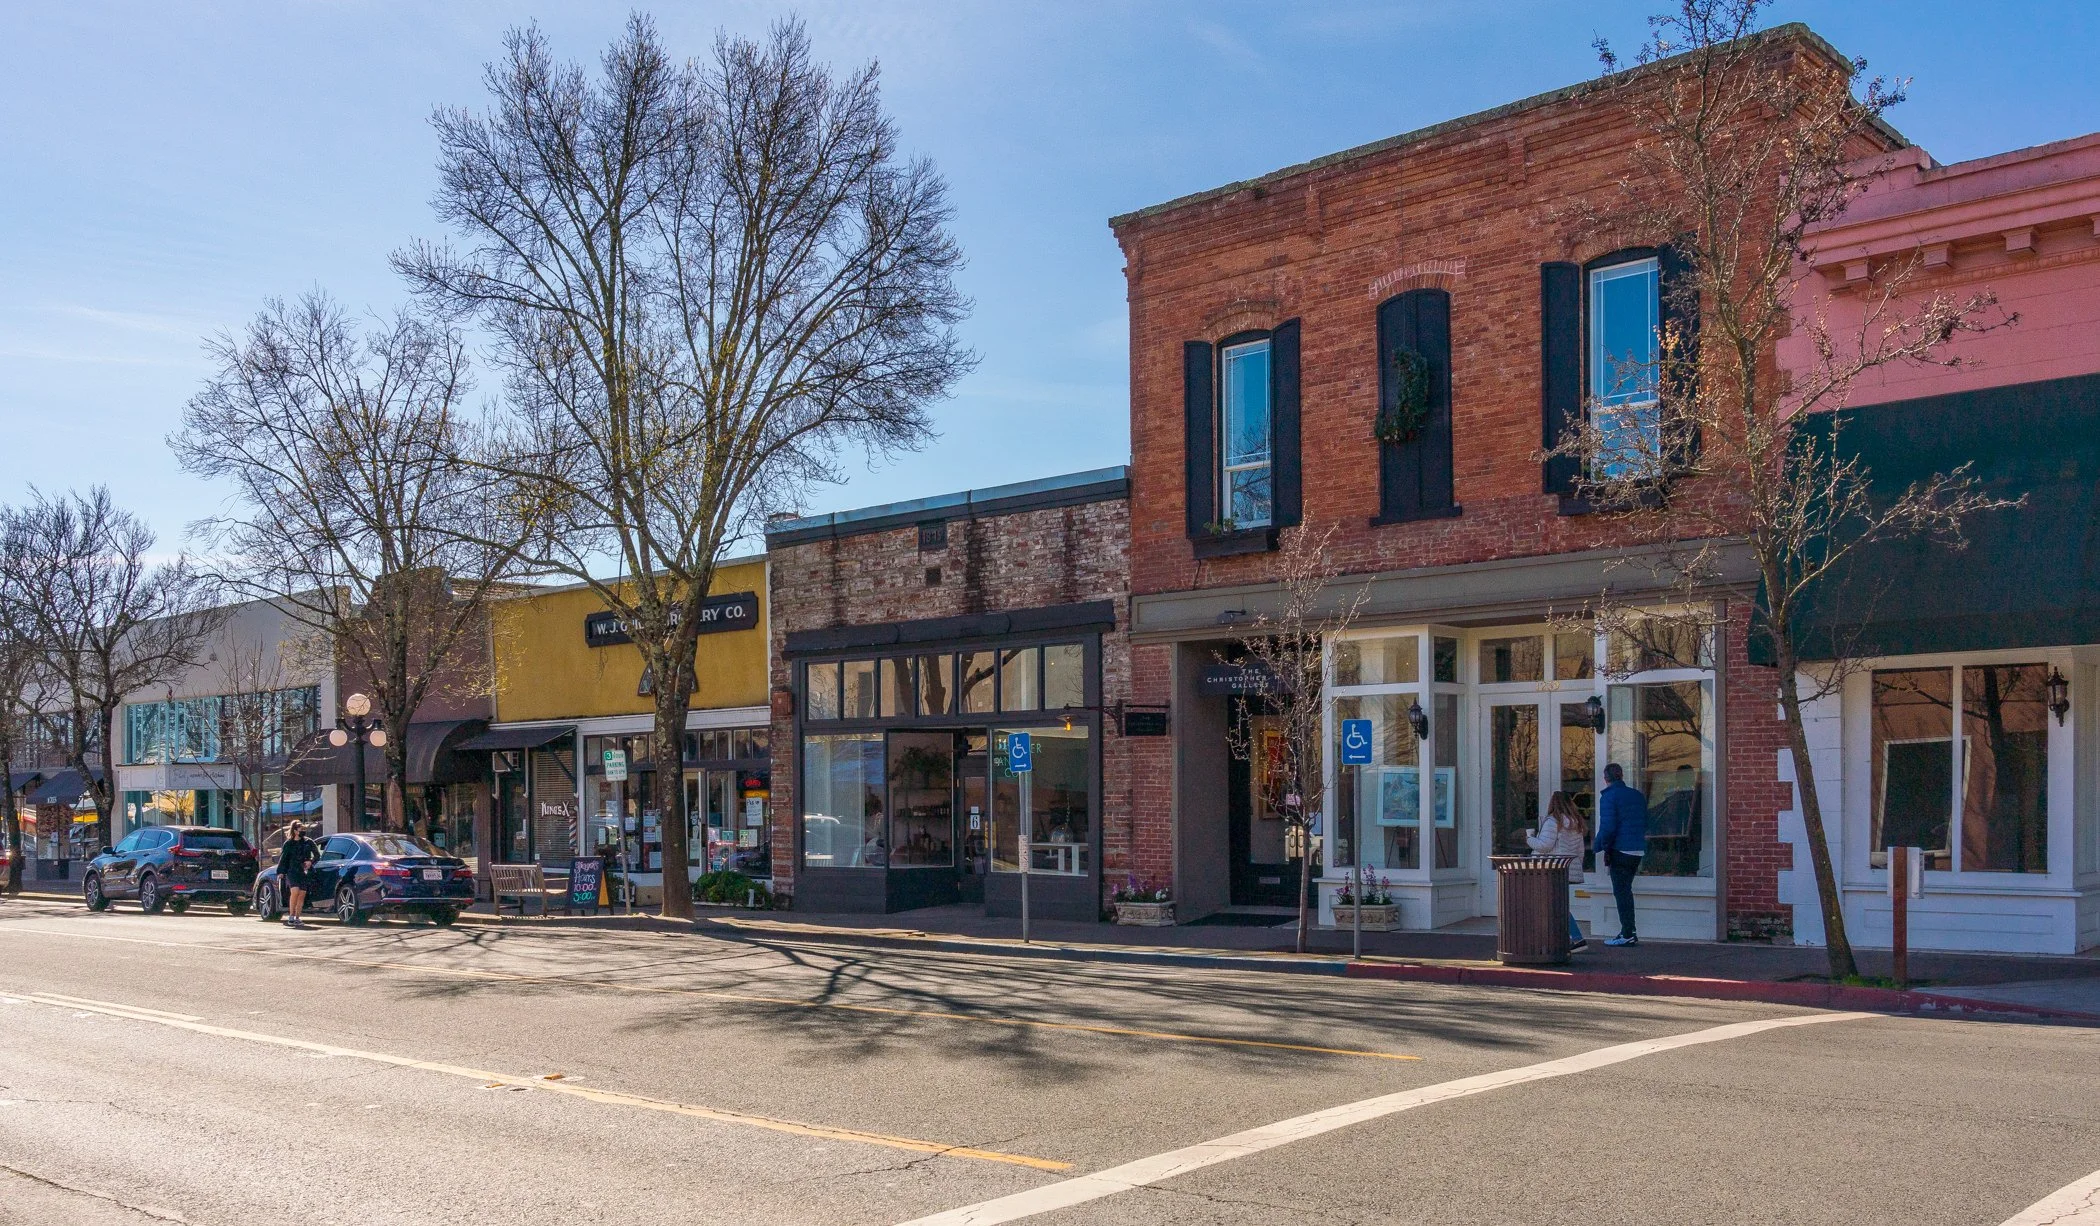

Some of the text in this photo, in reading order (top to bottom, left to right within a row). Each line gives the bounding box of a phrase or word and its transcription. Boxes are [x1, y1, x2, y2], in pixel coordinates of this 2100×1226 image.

[725, 605, 746, 619] CO.
[1206, 674, 1267, 684] CHRISTOPHER
[606, 761, 625, 769] PARKING
